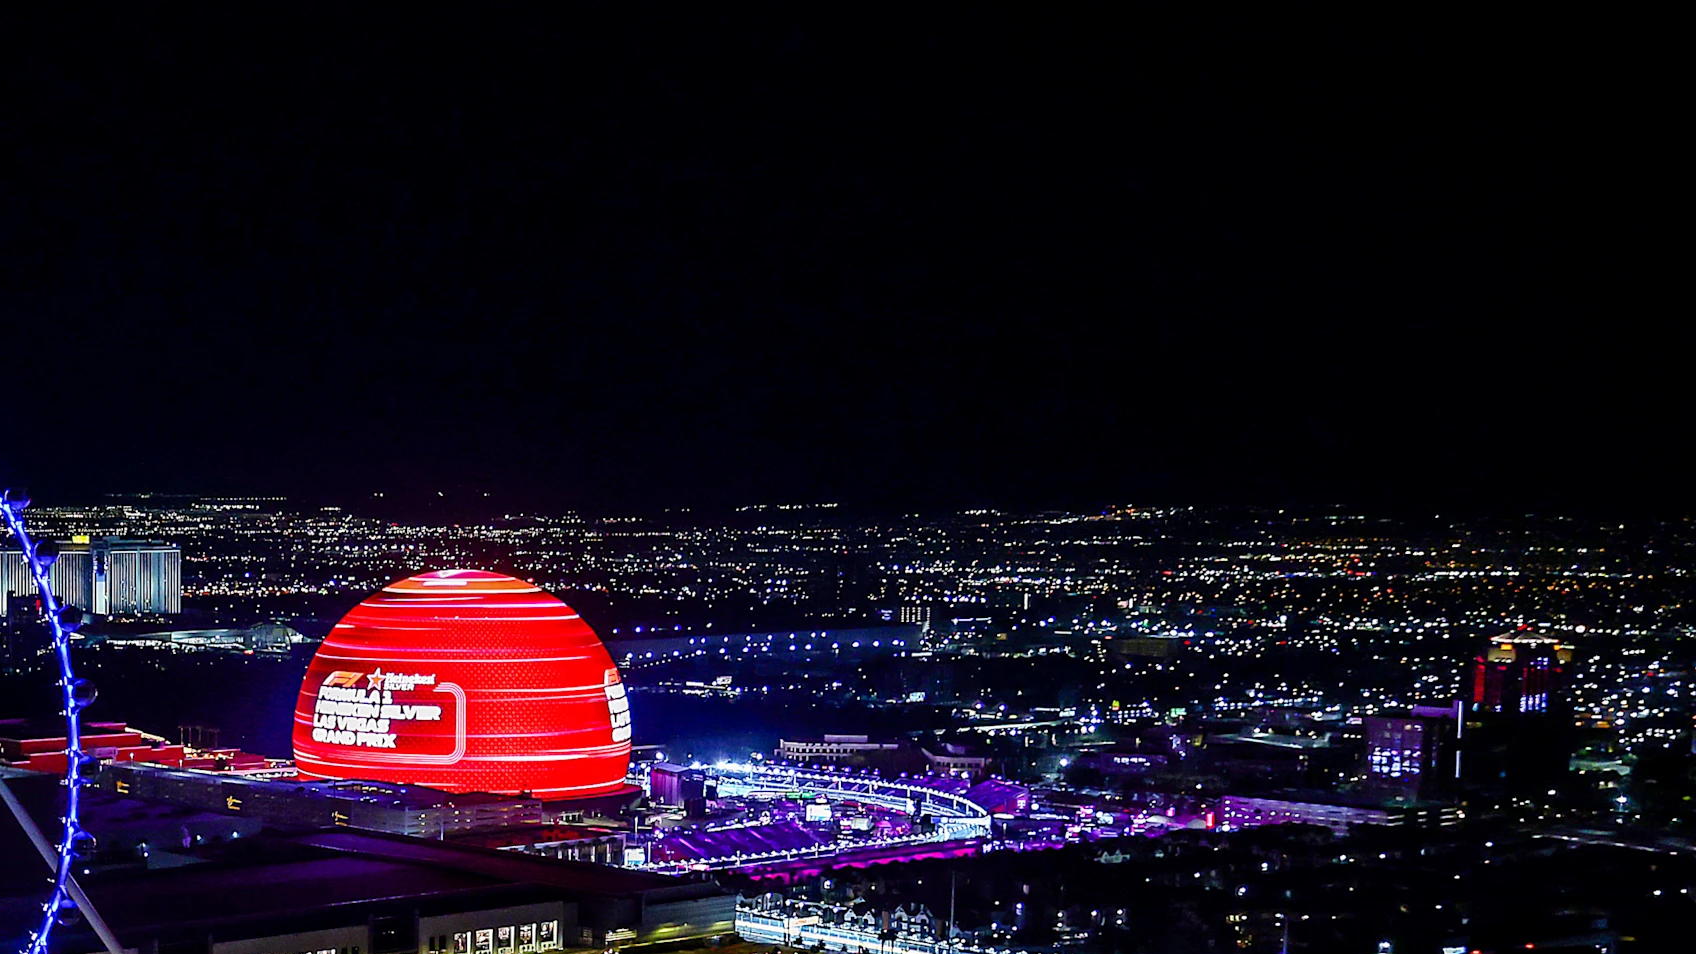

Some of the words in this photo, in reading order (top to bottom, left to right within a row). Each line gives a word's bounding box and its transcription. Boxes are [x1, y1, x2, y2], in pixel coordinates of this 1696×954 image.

[319, 686, 380, 704] FORMULA
[380, 705, 441, 720] SILVER
[314, 714, 336, 729] LAS
[337, 716, 390, 732] VEGAS
[313, 728, 356, 745] GRAND
[357, 732, 396, 748] PRIX
